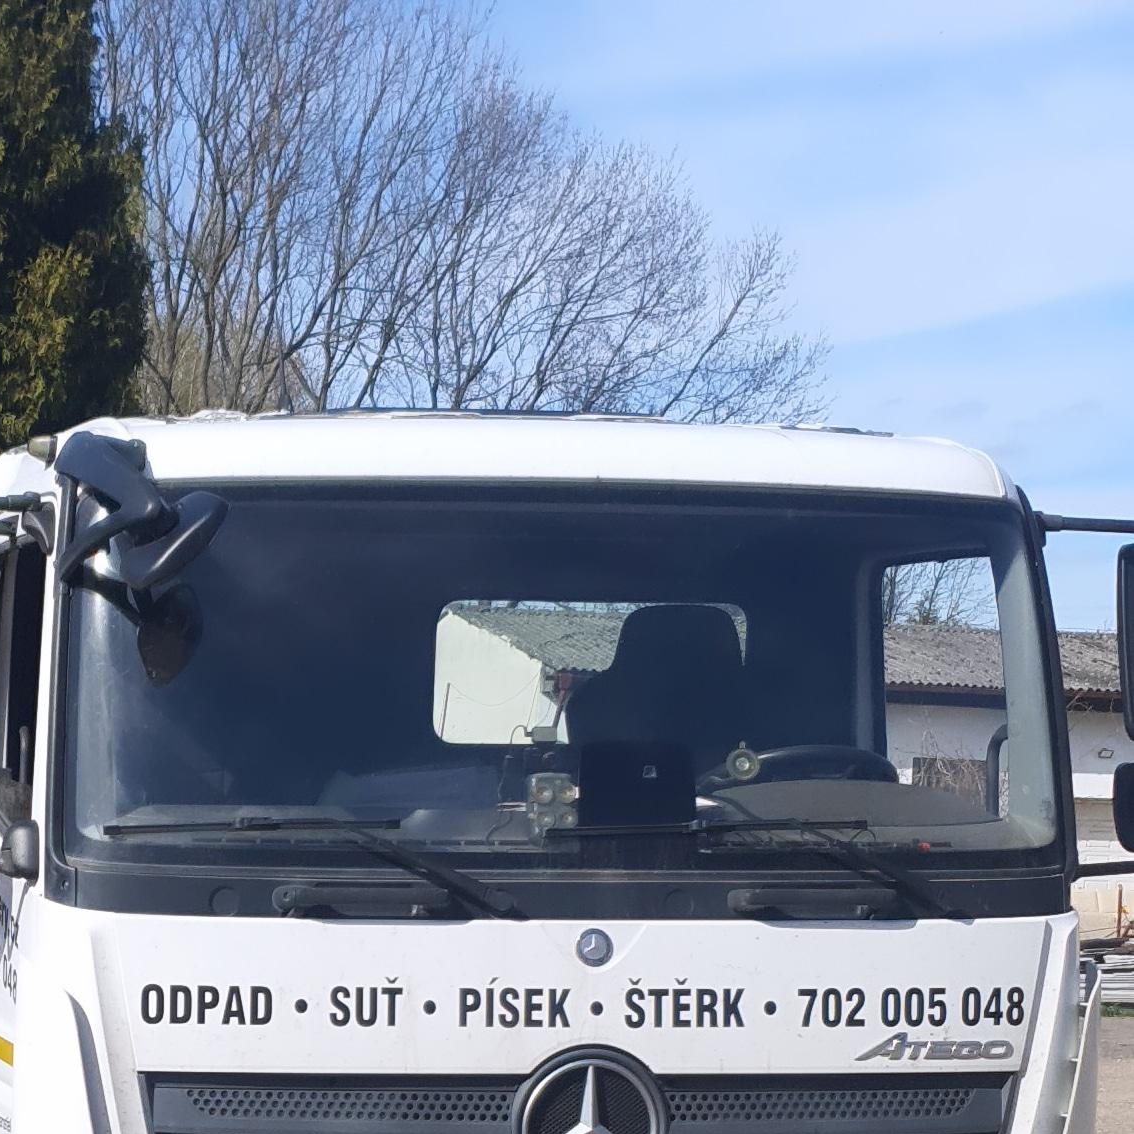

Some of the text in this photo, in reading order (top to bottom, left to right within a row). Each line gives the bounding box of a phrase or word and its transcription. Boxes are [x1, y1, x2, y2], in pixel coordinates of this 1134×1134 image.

[3, 954, 18, 1005] 048
[140, 976, 1025, 1029] ODPAD SUŤ PÍSEK ŠTĚRK 702 005 048
